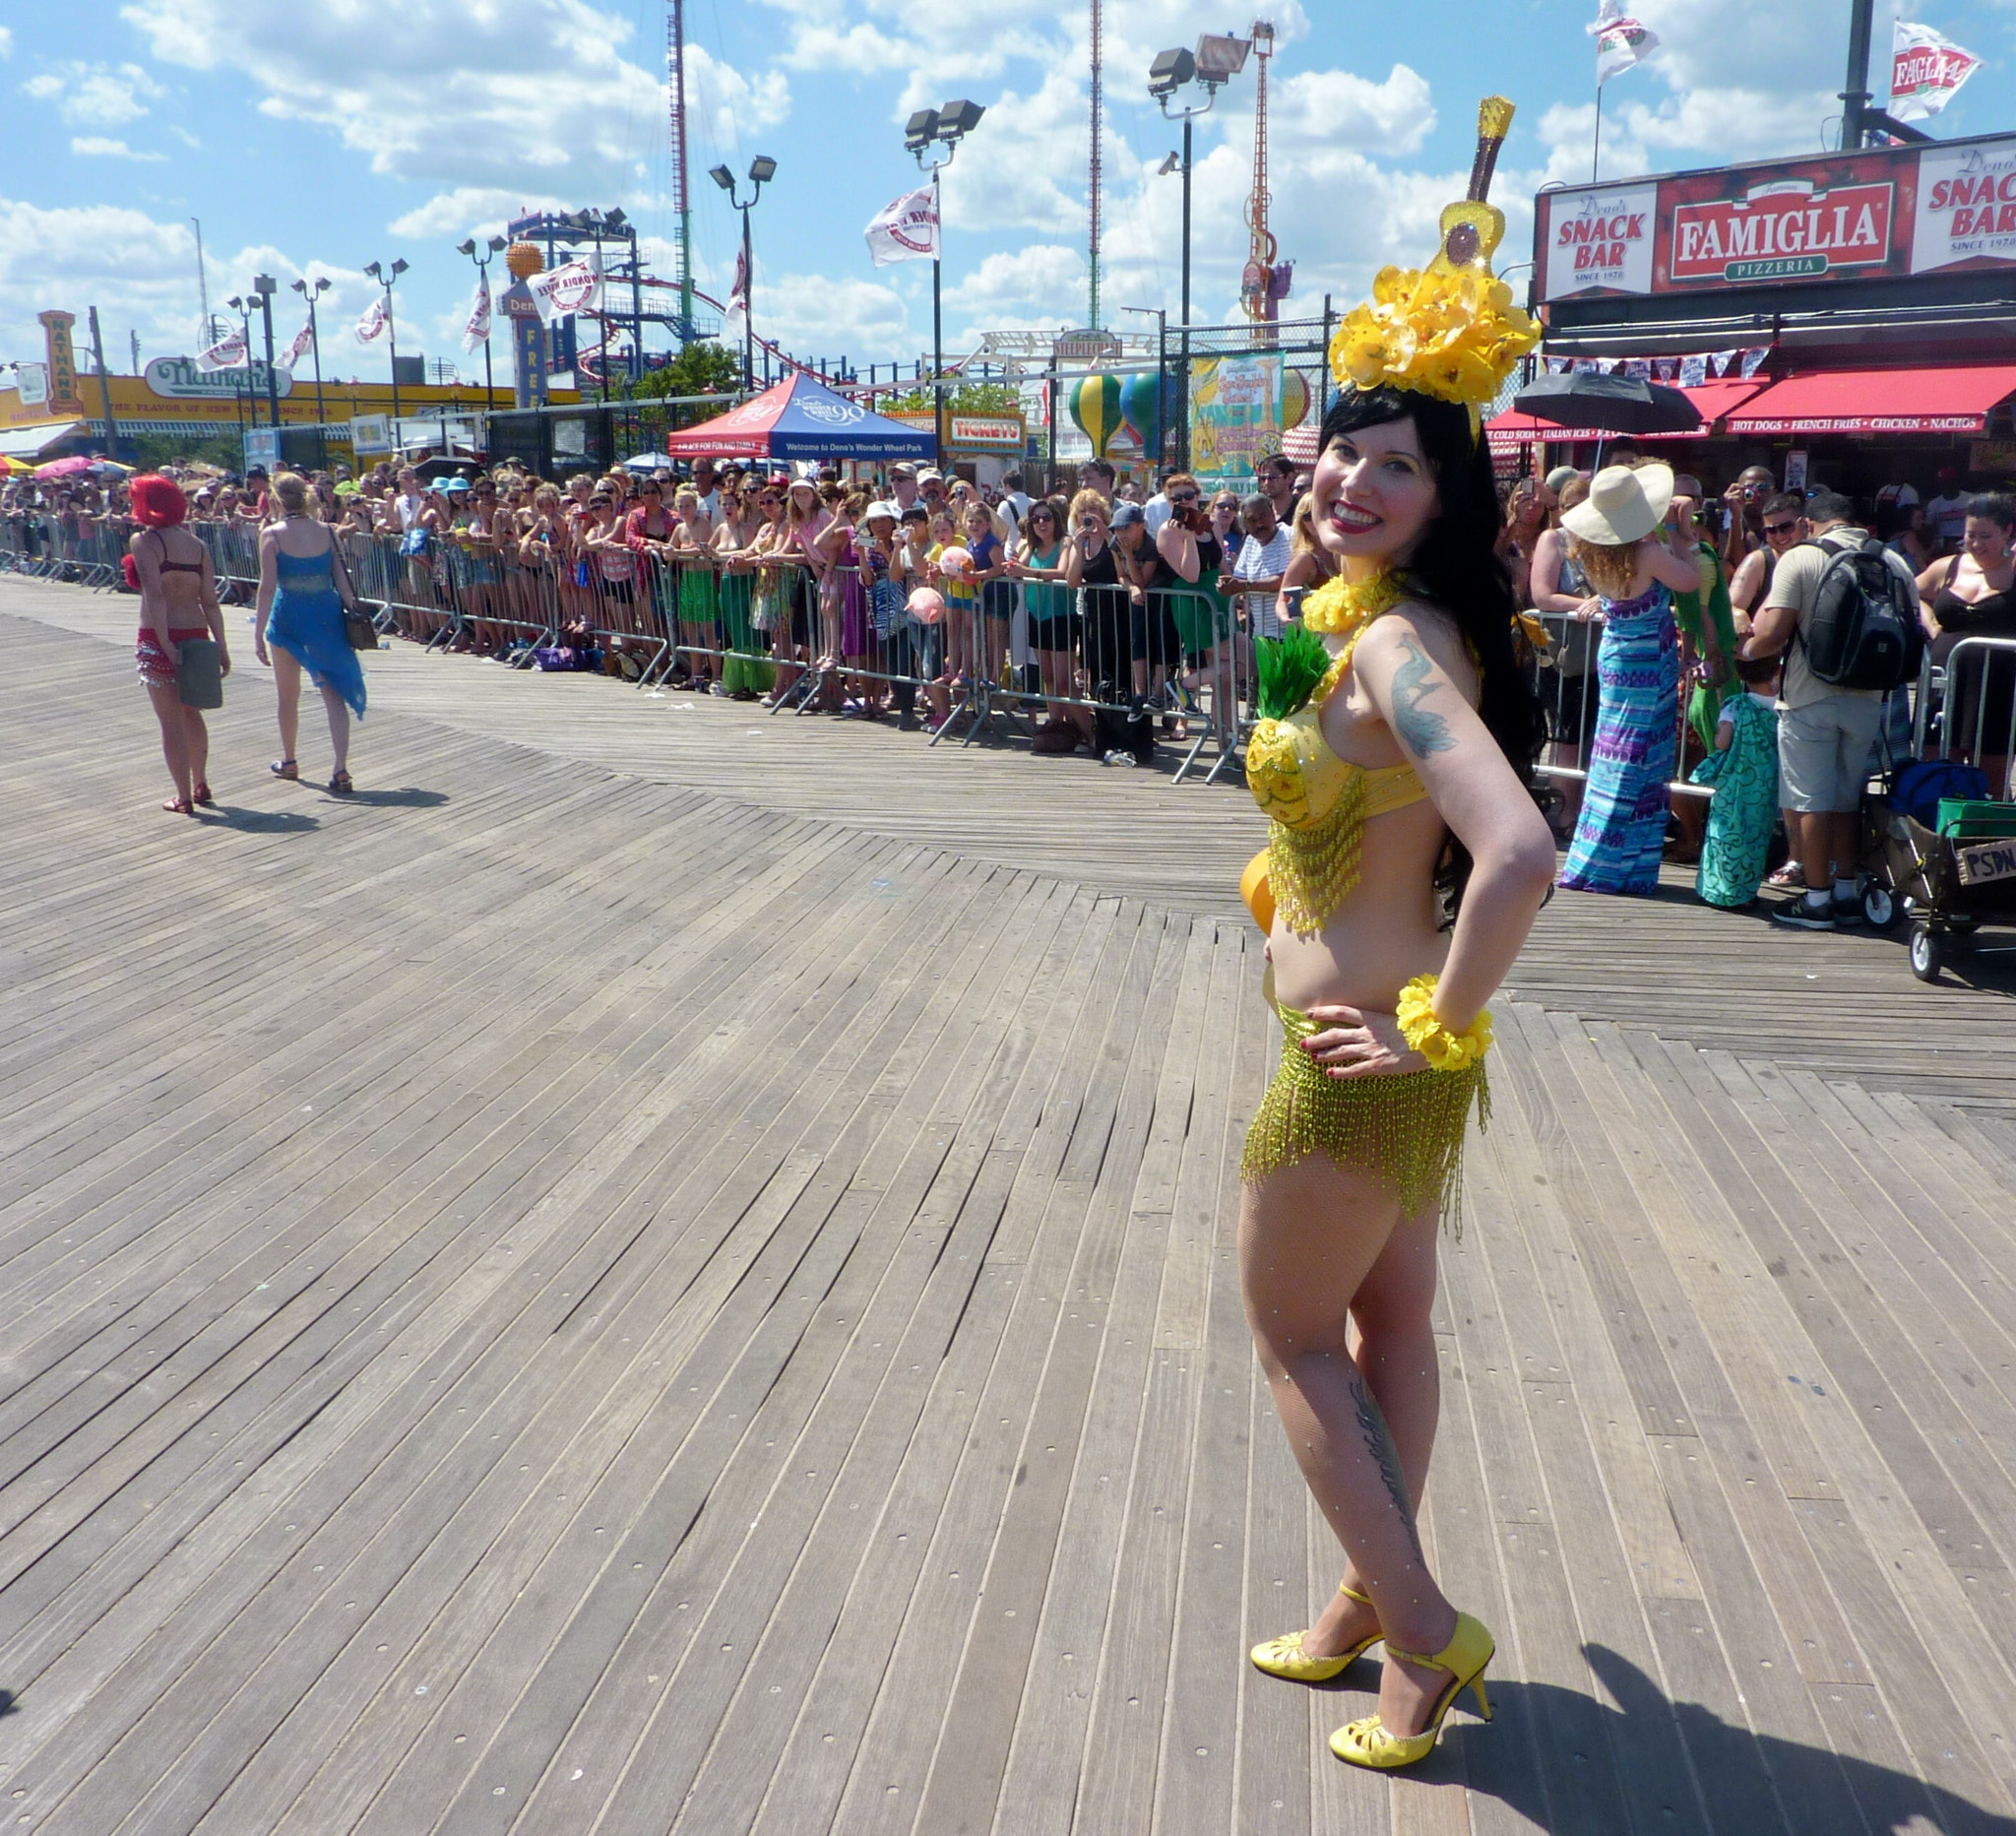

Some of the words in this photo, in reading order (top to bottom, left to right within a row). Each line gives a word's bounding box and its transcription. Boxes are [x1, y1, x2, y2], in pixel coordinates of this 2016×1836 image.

[1578, 194, 1626, 216] Deno's
[1950, 203, 2016, 237] BAR
[1557, 213, 1646, 246] SNACK
[1678, 203, 1879, 262] FAMIGLIA
[1950, 240, 1984, 251] SINCE
[1989, 237, 2016, 248] 1970
[1574, 241, 1626, 270] BAR
[1575, 272, 1600, 282] SINCE
[1604, 271, 1623, 280] 1970
[1736, 259, 1814, 277] PIZZERIA
[52, 320, 72, 400] NATHANS
[954, 421, 1018, 439] TICKETS
[1732, 420, 1753, 430] HOT
[1754, 420, 1783, 430] DOGS
[1792, 419, 1833, 430] FRENCH
[1833, 418, 1860, 429] FRIES
[1870, 417, 1920, 428] CHICKEN
[1929, 417, 1977, 428] NACHOS
[1493, 430, 1515, 439] COLD
[1515, 430, 1535, 439] SODA
[1543, 429, 1572, 439] ITALIAN
[1572, 429, 1590, 438] ICES
[884, 443, 906, 452] Wheel
[907, 443, 922, 452] Park
